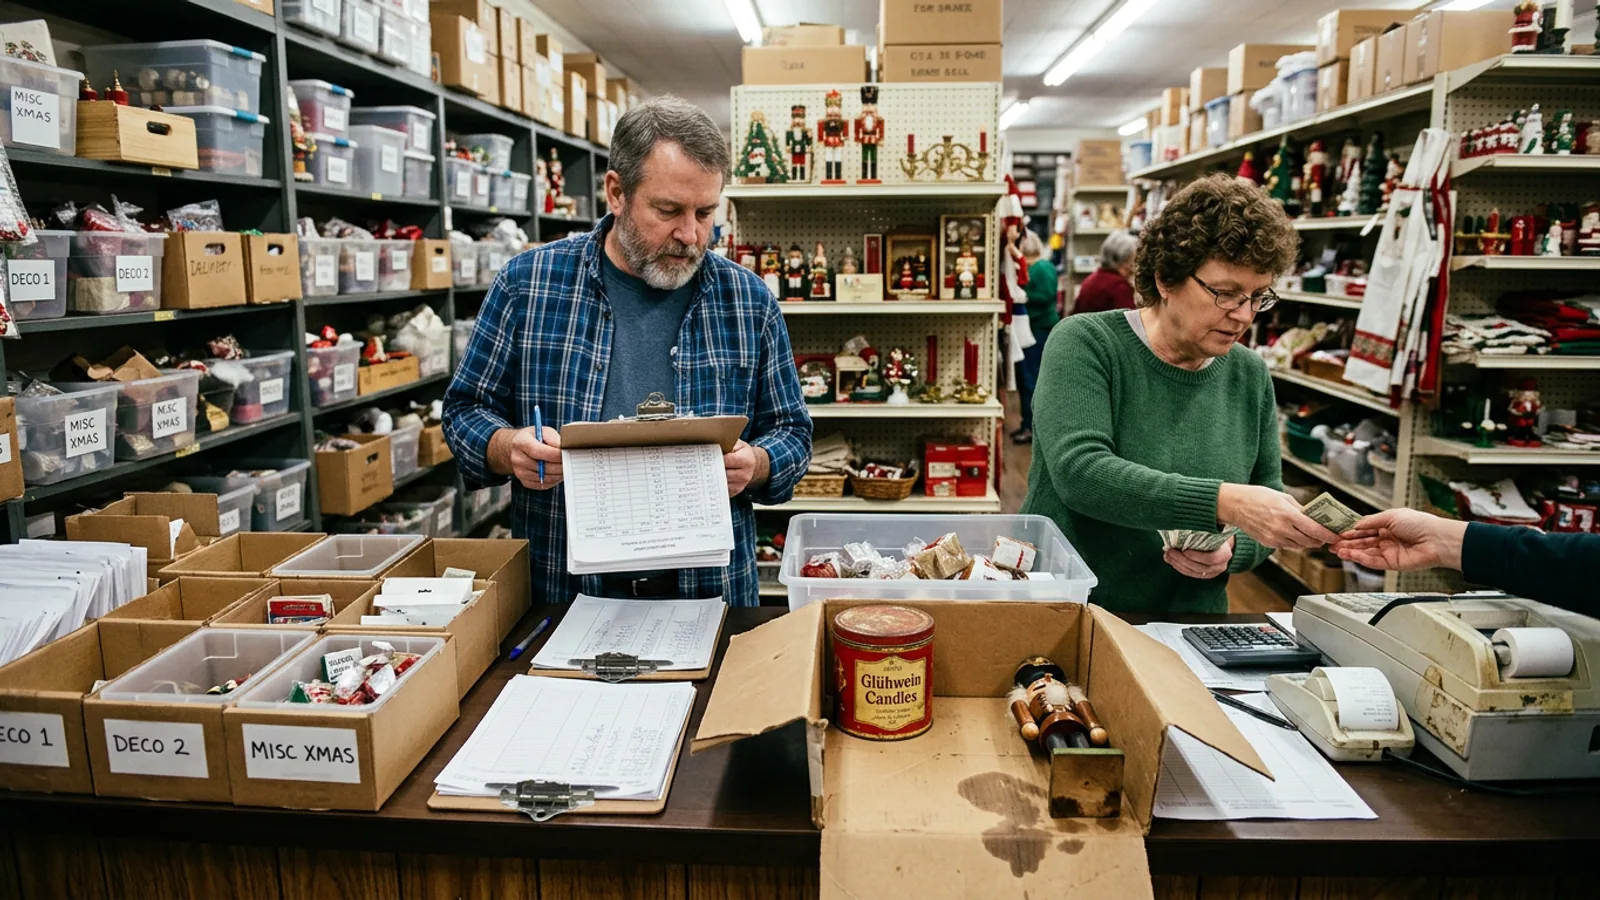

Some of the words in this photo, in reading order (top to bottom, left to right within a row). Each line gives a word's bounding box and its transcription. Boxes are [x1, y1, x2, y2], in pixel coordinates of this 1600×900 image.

[14, 90, 43, 106] MISC
[15, 106, 52, 123] XMAS
[11, 272, 41, 285] DECO
[43, 273, 50, 285] 1
[118, 267, 142, 279] DECO
[143, 268, 149, 278] 2
[70, 417, 96, 432] MISC
[156, 416, 181, 431] XMAS
[70, 432, 99, 449] XMAS
[861, 673, 921, 690] Glühwein
[865, 690, 918, 705] Candles
[40, 727, 54, 747] 1
[112, 734, 165, 754] DECO
[173, 738, 190, 756] 2
[251, 740, 298, 760] MISC
[303, 744, 355, 764] XMAS
